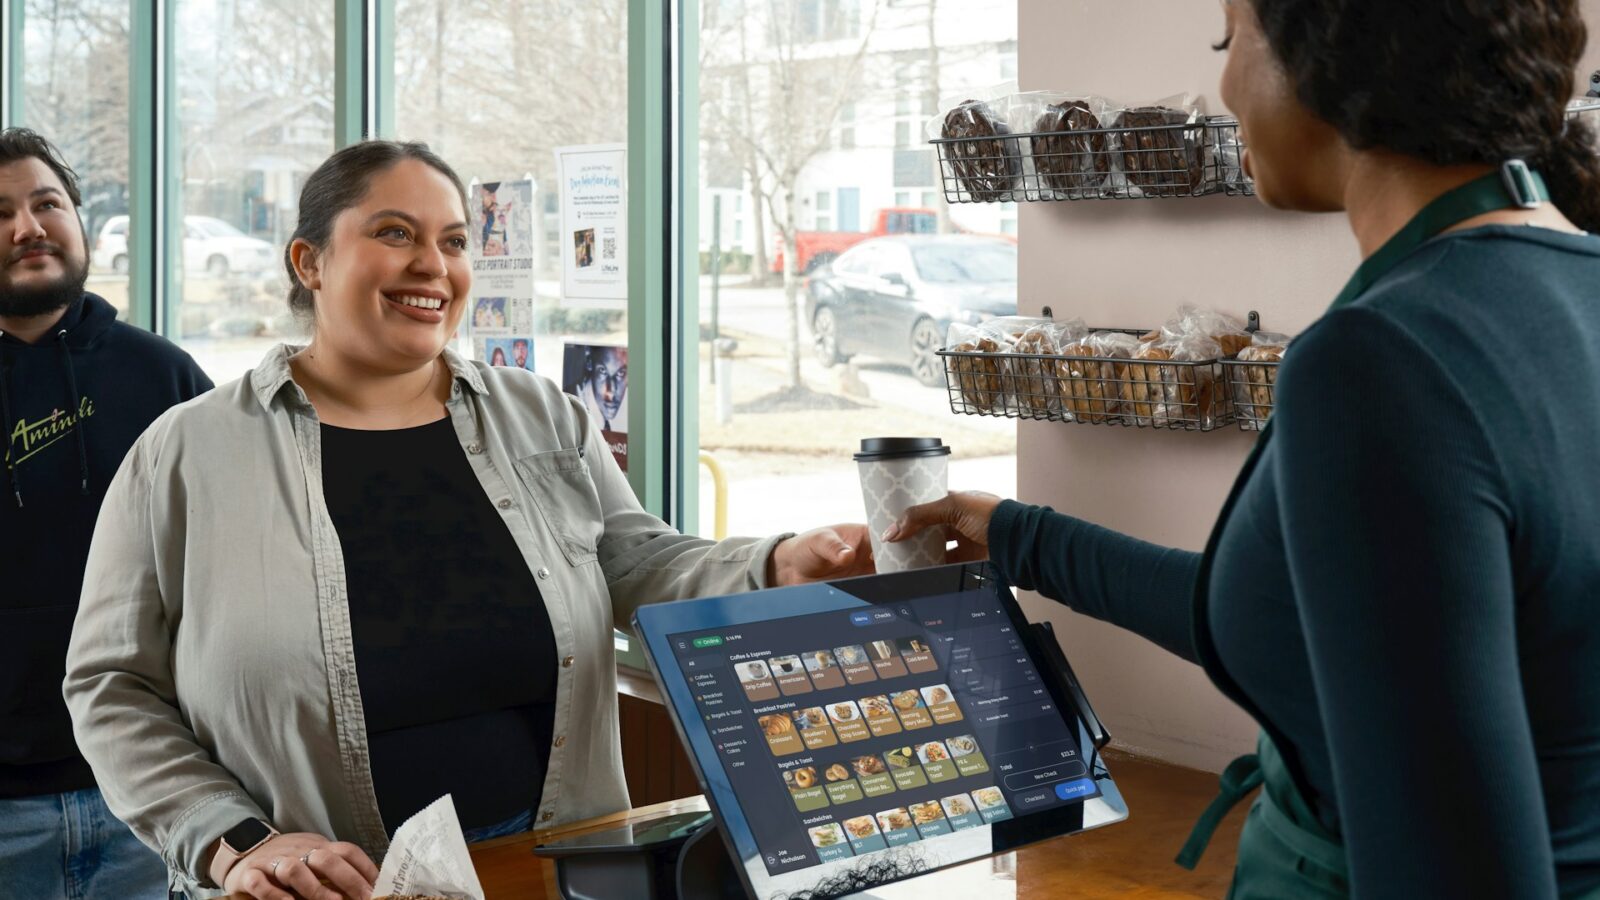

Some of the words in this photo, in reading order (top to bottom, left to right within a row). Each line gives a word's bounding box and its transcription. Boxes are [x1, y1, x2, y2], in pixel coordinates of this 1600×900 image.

[486, 259, 513, 270] PORTRAIT
[513, 258, 533, 270] STUDIO
[717, 725, 743, 733] Sandwiches
[804, 730, 828, 739] Blueberry
[770, 736, 793, 744] Croissant
[778, 761, 795, 769] Bagels
[895, 770, 916, 778] Avocado
[862, 777, 887, 785] Cinnamon
[828, 783, 855, 794] Everything
[807, 790, 823, 798] Bagel
[832, 793, 848, 801] Bagel
[1024, 794, 1046, 803] Checkout
[803, 814, 833, 825] Sandwiches
[920, 824, 940, 833] Chicken
[888, 832, 908, 841] Caprese
[820, 849, 839, 858] Turkey
[781, 854, 806, 864] Nicholson
